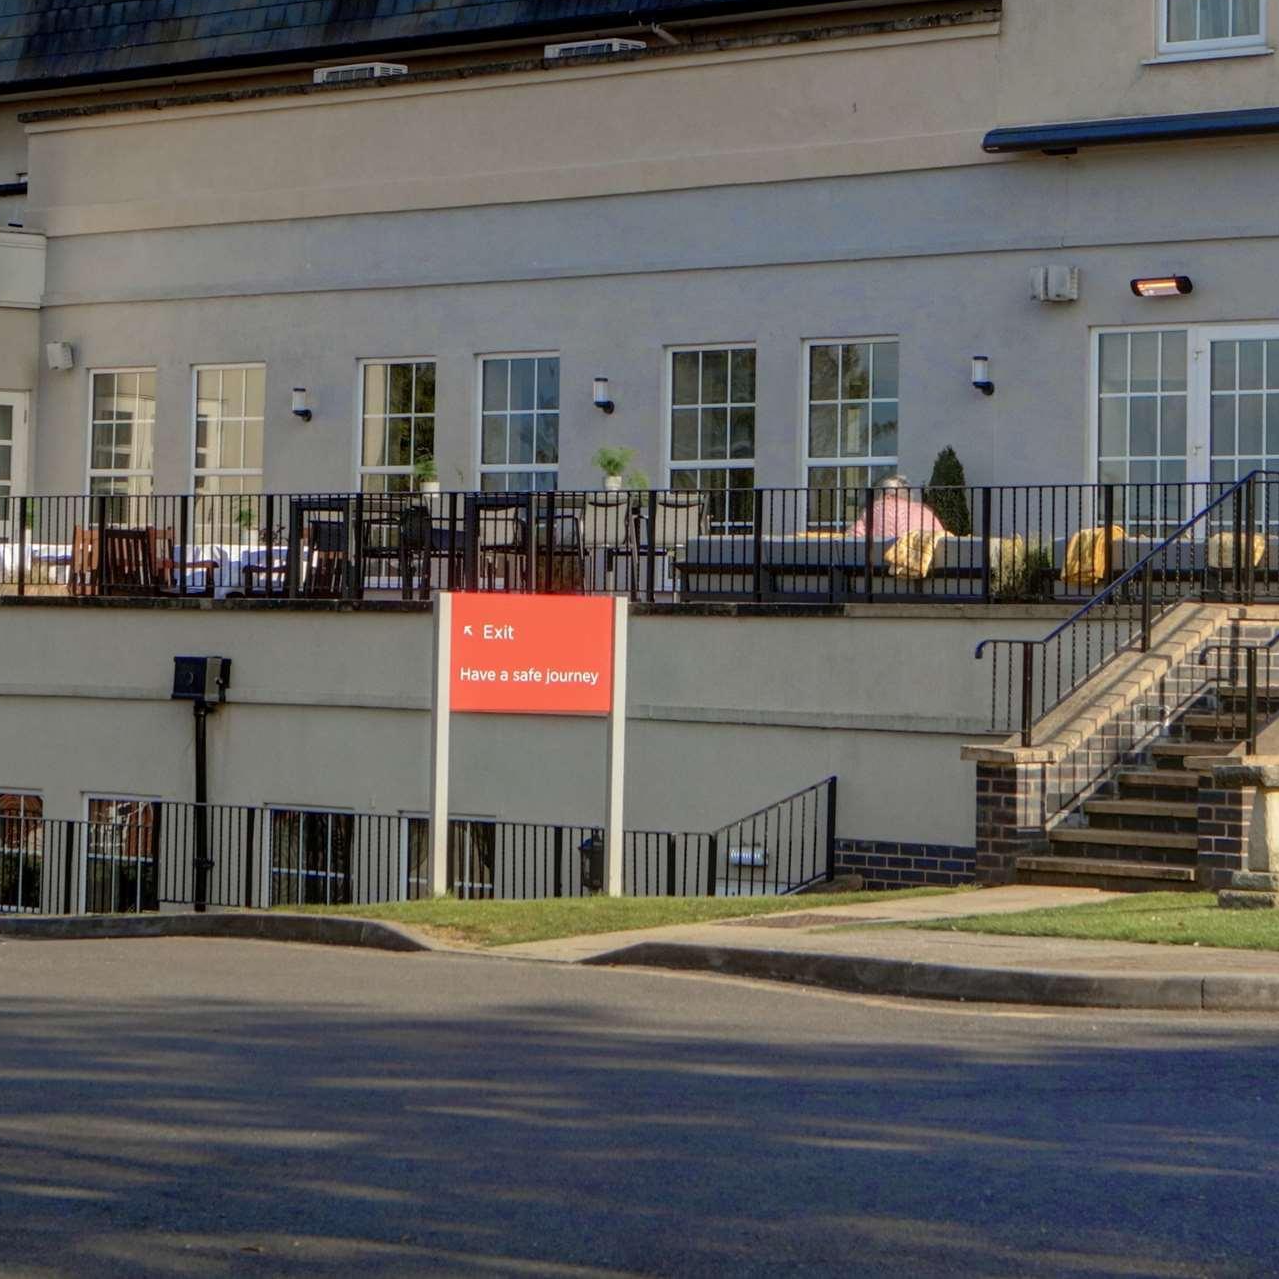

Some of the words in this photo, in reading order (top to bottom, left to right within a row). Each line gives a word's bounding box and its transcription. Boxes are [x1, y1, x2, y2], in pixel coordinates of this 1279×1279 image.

[483, 624, 515, 640] Exit
[460, 667, 496, 681] Have
[500, 670, 509, 682] a
[513, 667, 542, 682] safe
[545, 668, 599, 686] journey
